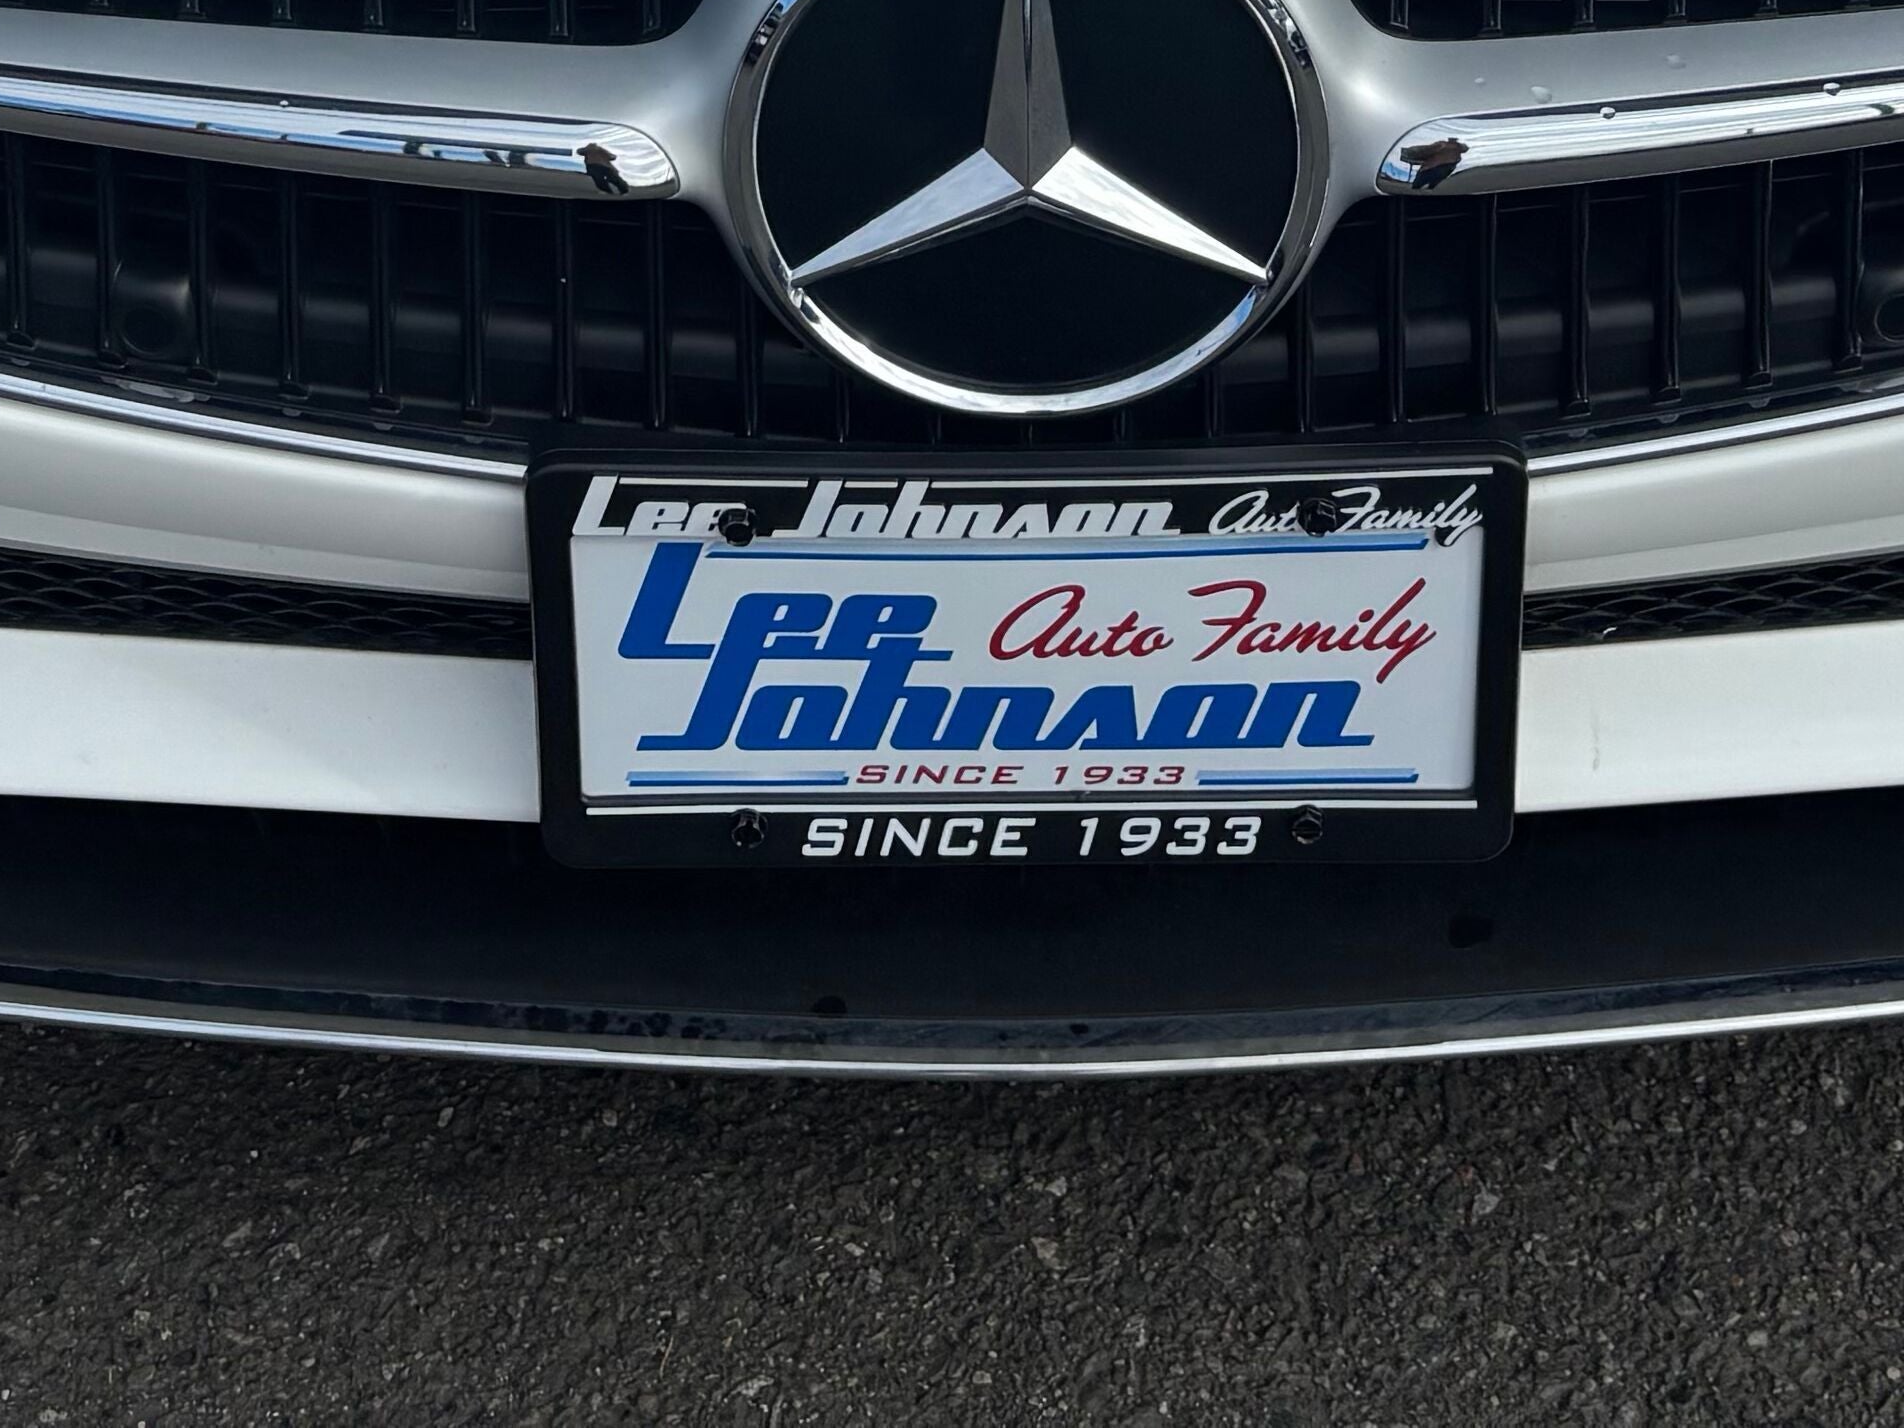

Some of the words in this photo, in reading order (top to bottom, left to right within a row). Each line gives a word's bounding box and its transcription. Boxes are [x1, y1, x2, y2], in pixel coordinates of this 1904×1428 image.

[771, 478, 1181, 538] Johnson
[1208, 488, 1320, 537] Aut
[1326, 483, 1483, 545] Family
[617, 542, 953, 660] Lee
[988, 583, 1175, 661] Auto
[1186, 576, 1437, 685] Family
[636, 641, 1376, 752] Johnson
[855, 764, 1025, 785] SINCE
[1053, 764, 1186, 785] 1933
[800, 816, 1037, 858] SINCE
[1078, 815, 1263, 857] 1933
